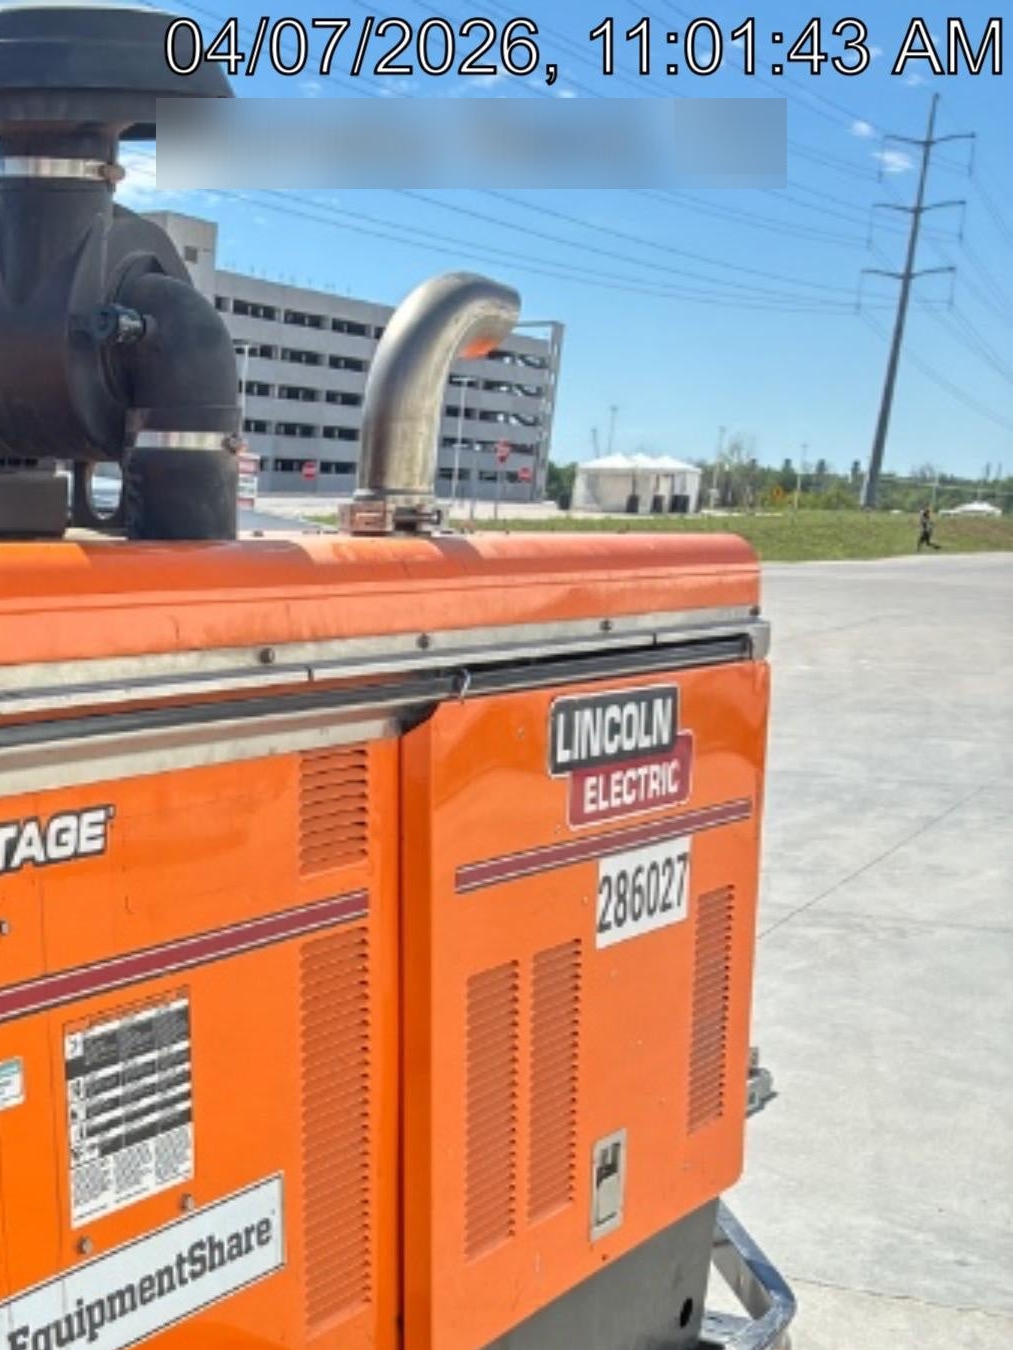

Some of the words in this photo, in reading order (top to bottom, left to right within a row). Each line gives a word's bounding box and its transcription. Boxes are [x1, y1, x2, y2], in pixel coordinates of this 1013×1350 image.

[556, 697, 673, 763] LINCOLN
[583, 758, 680, 814] ELECTRIC
[596, 852, 689, 934] 286027
